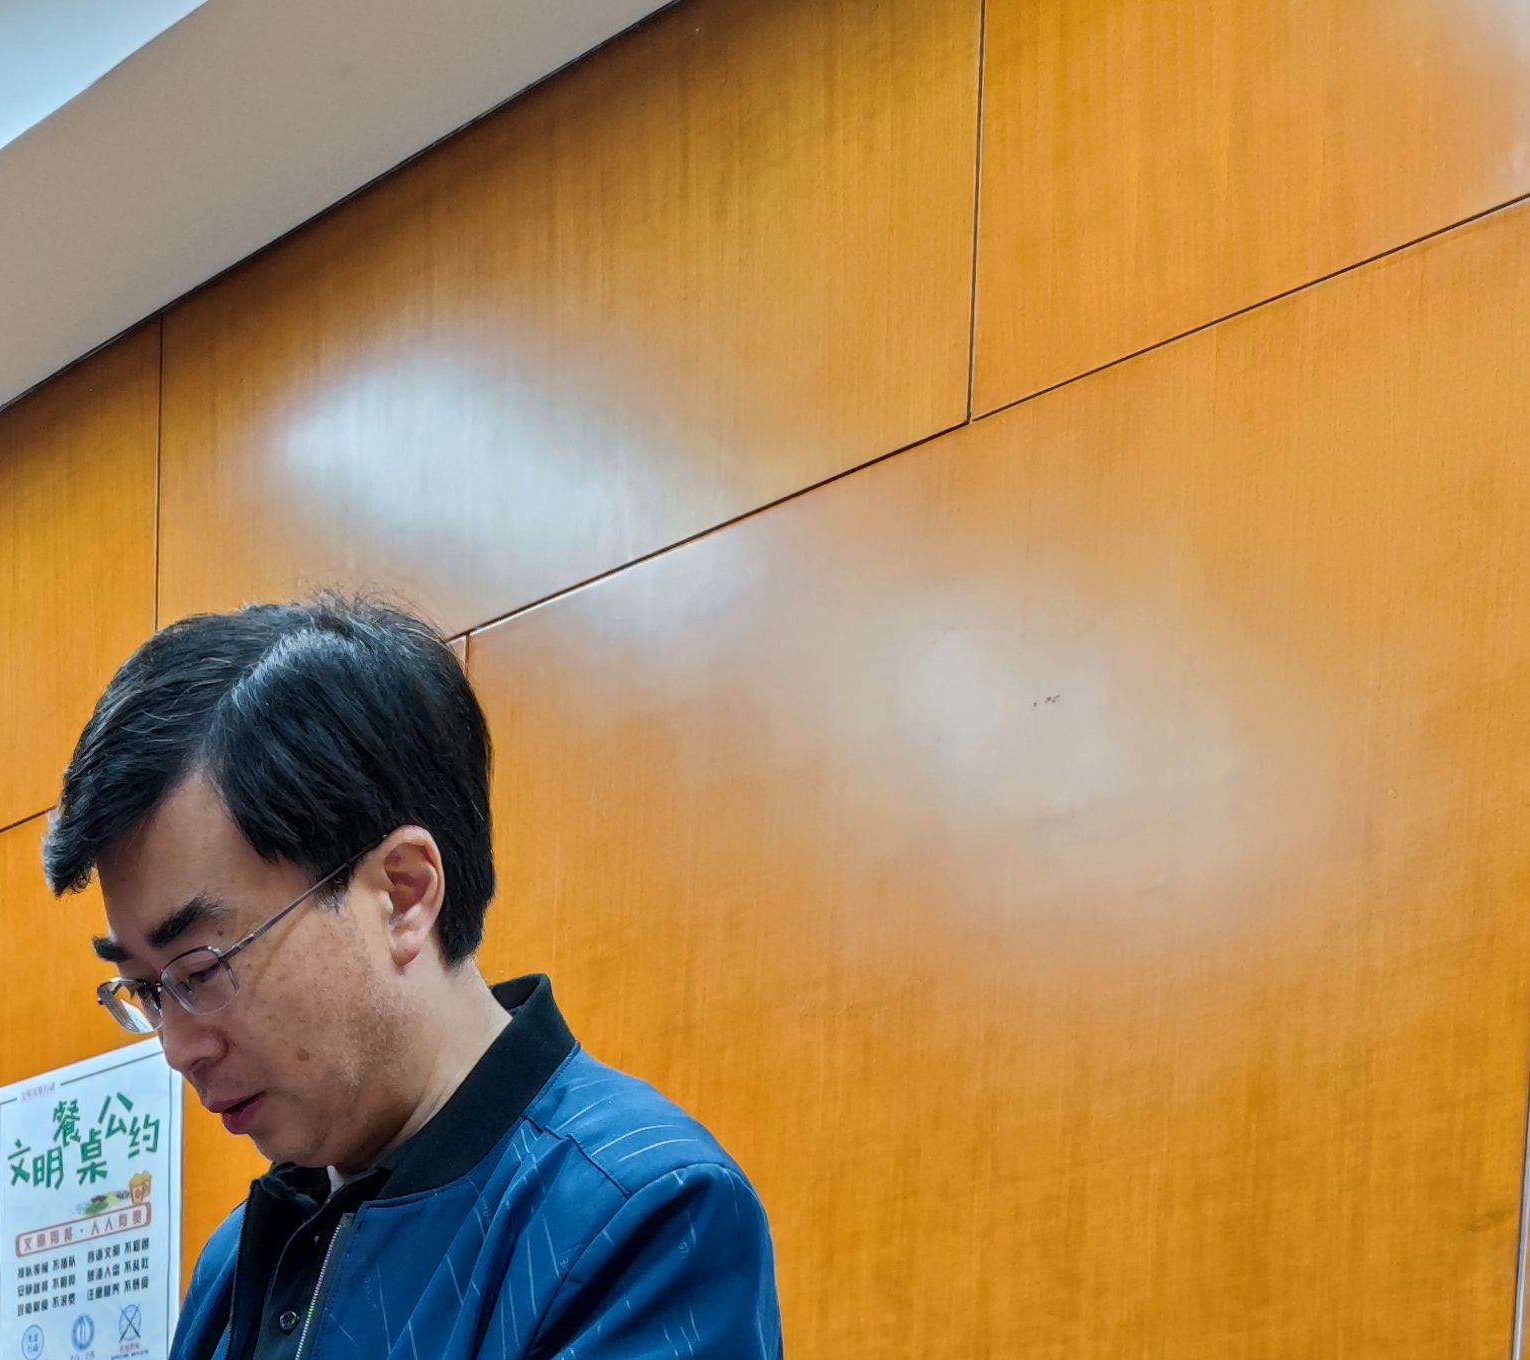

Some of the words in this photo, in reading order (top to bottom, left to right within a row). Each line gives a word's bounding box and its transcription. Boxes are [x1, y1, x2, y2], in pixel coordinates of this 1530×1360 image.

[7, 1092, 160, 1190] 文明餐桌公约
